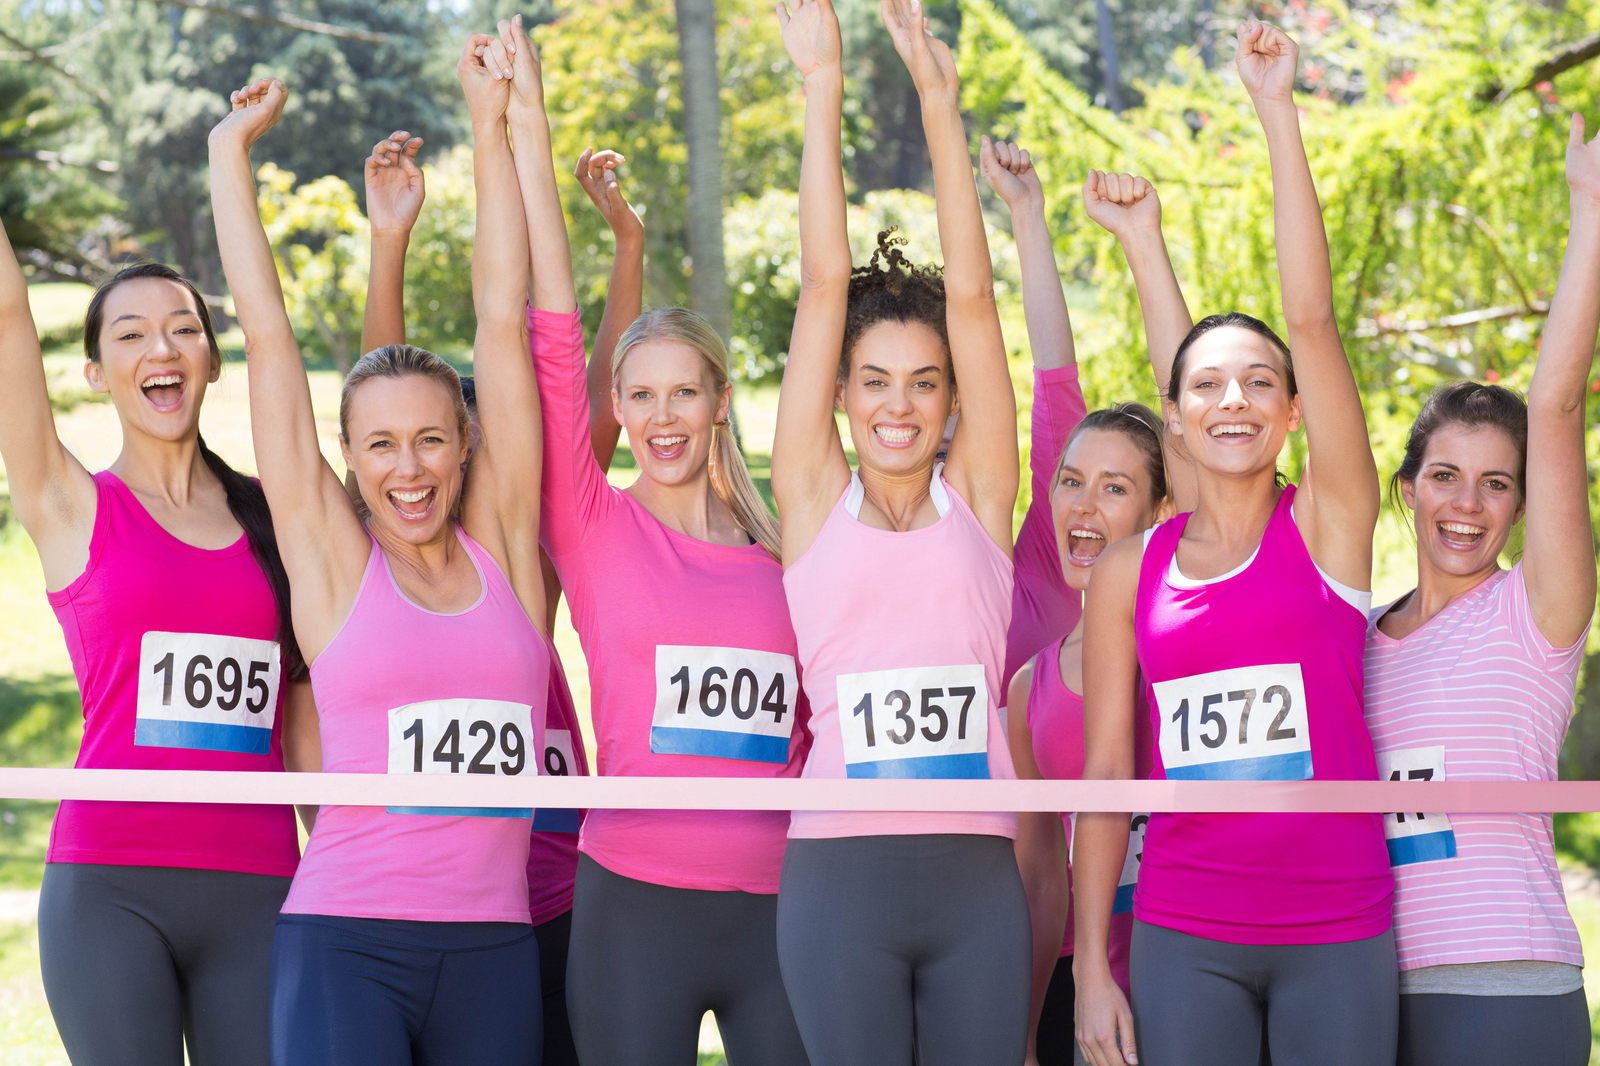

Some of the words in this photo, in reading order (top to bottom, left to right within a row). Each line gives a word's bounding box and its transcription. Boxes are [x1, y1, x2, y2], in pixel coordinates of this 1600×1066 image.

[153, 652, 270, 714] 1695
[670, 665, 788, 723] 1604
[402, 718, 526, 775] 1429
[853, 686, 977, 748] 1357
[1171, 684, 1297, 752] 1572
